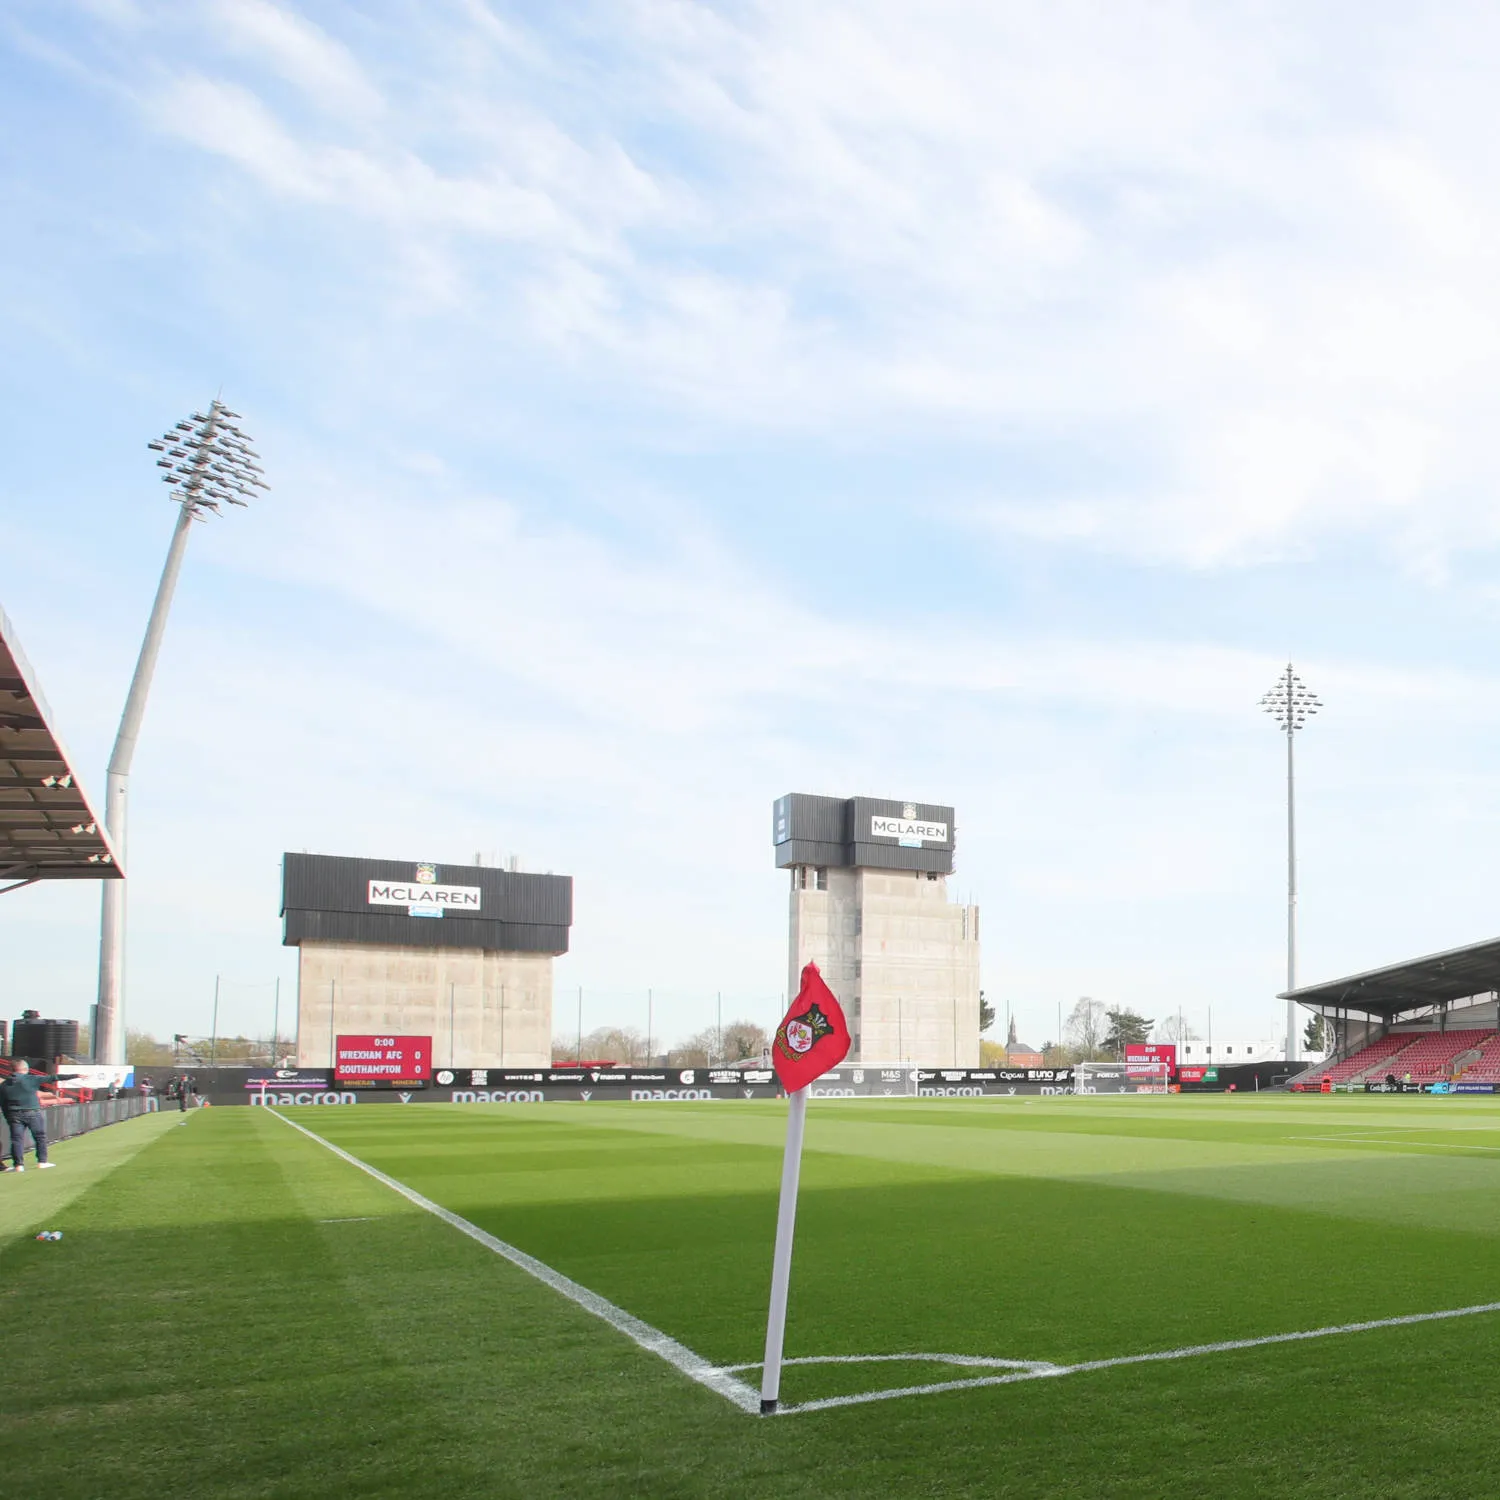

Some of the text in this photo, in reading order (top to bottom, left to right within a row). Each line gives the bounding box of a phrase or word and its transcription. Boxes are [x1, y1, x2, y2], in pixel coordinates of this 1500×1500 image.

[371, 885, 479, 904] MCLAREN
[374, 1038, 394, 1047] 0:00
[339, 1051, 421, 1060] WREXHAM AFC 0
[339, 1065, 421, 1074] SOUTHAMPTON 0
[452, 1091, 544, 1103] macron
[631, 1089, 711, 1101] macron
[919, 1086, 983, 1097] macron
[251, 1092, 356, 1106] macron
